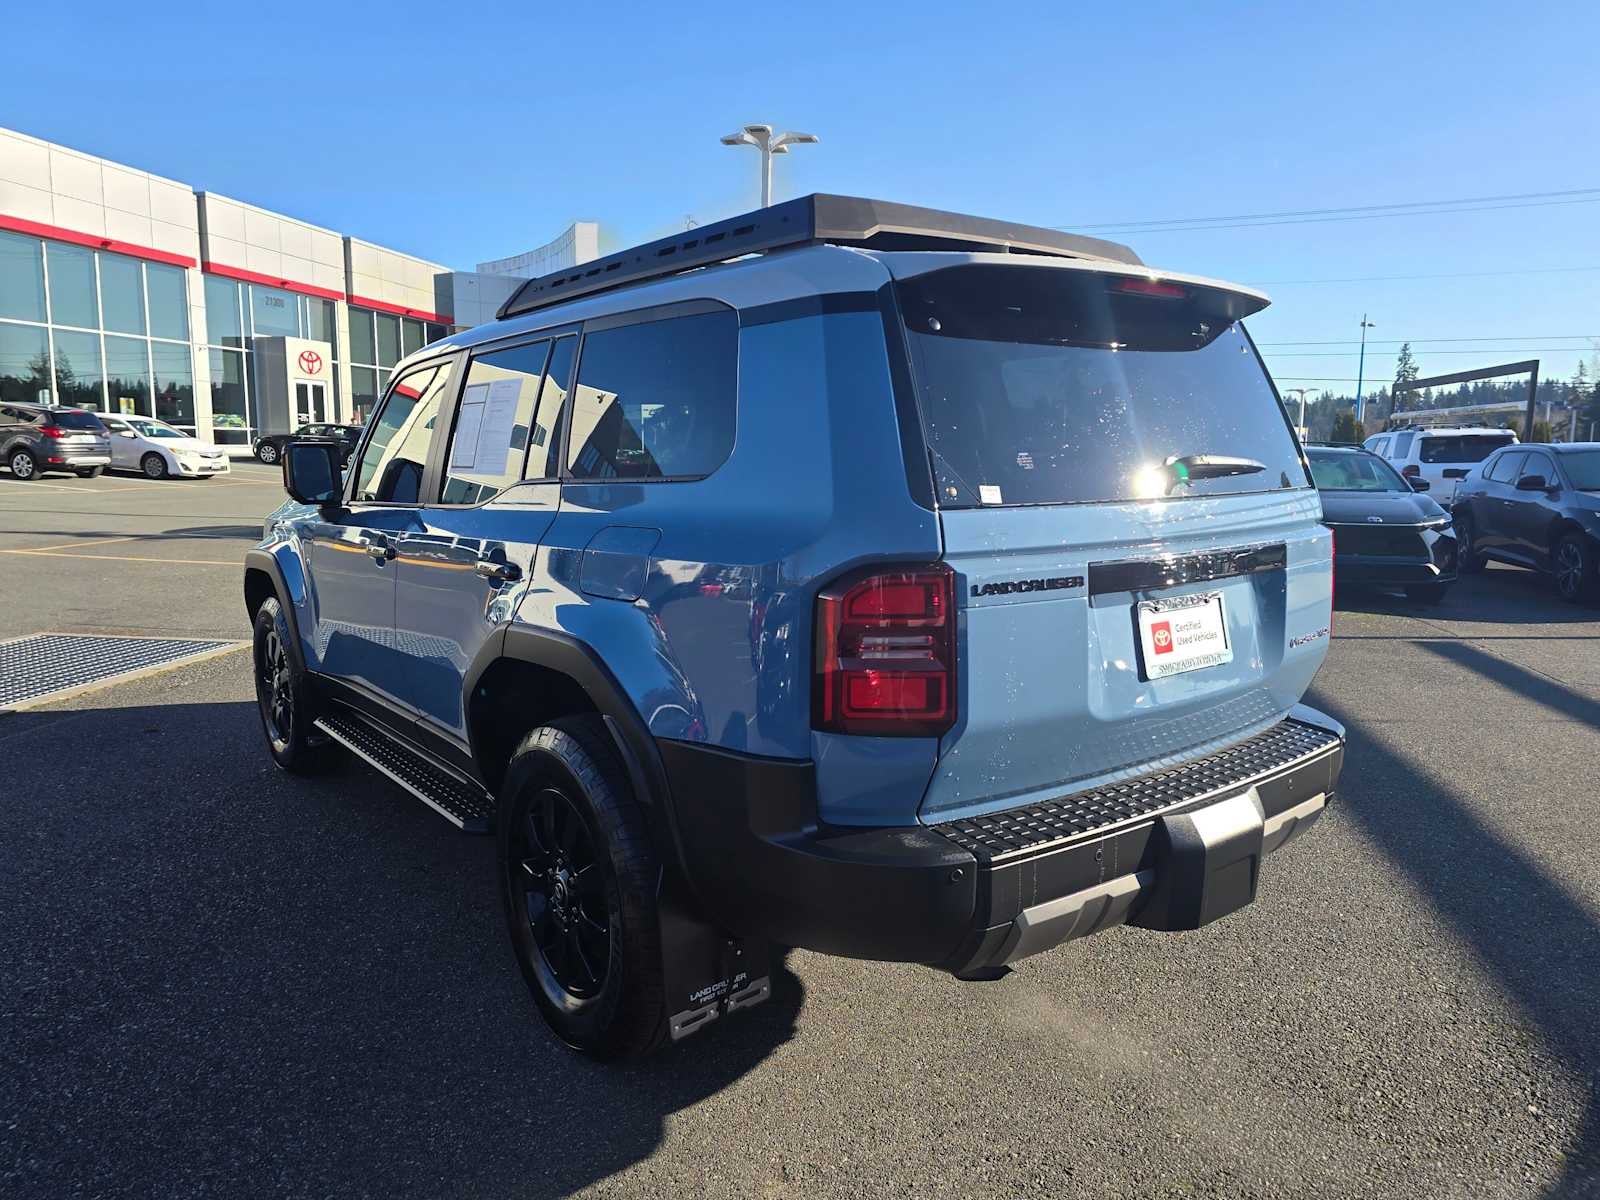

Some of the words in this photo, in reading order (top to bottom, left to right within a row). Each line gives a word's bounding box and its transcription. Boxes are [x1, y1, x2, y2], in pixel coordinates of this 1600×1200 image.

[1175, 620, 1202, 633] Certified
[1177, 635, 1193, 646] Used
[1194, 630, 1218, 642] Vehicles
[690, 987, 711, 1002] LAND
